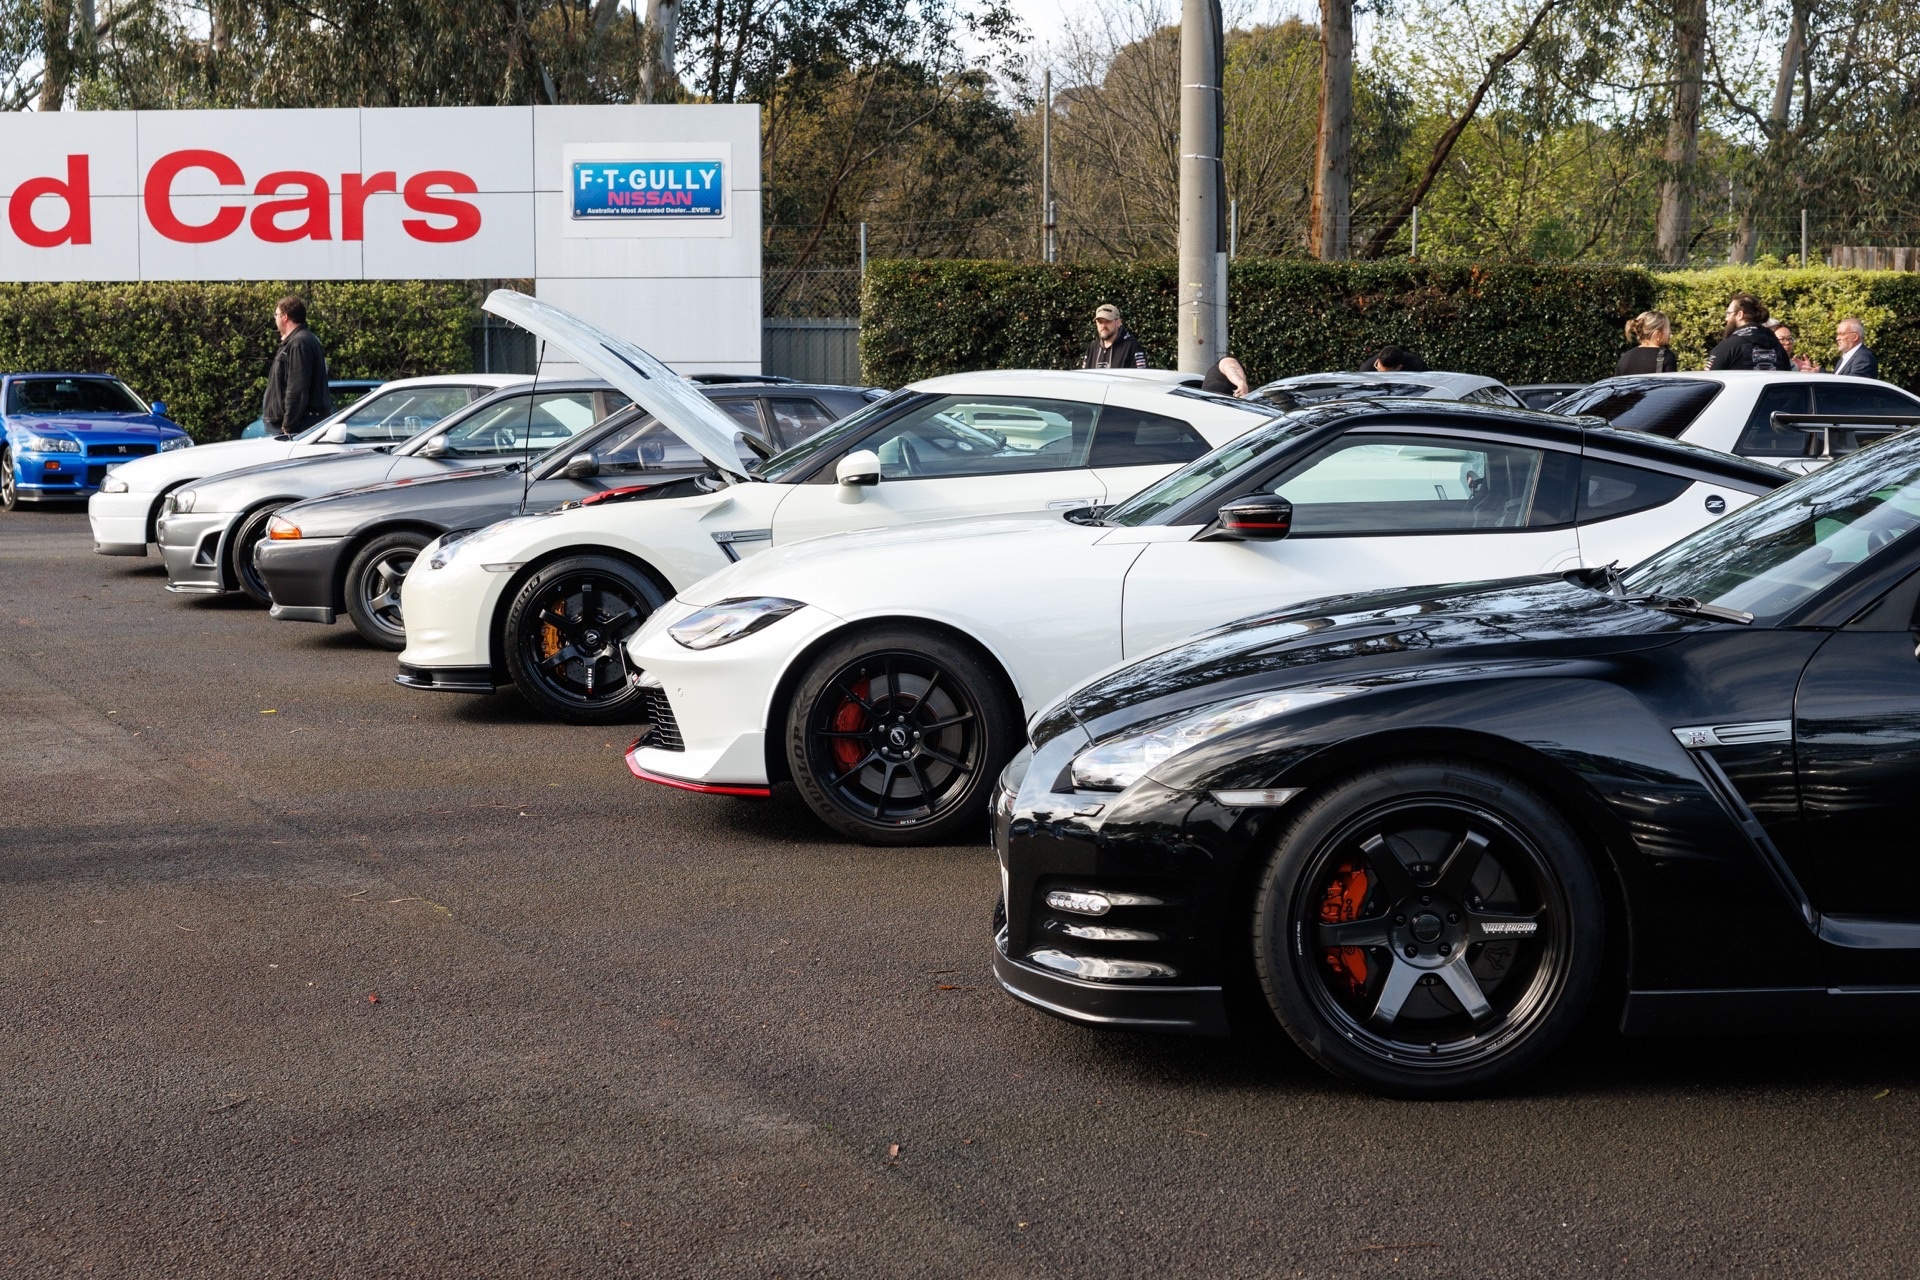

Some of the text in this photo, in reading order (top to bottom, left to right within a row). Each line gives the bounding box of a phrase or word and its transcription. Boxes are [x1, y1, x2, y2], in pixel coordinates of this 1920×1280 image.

[144, 149, 482, 243] Cars
[608, 191, 692, 206] NISSAN
[508, 576, 541, 634] MICHELIN
[794, 726, 839, 816] DUNLOP
